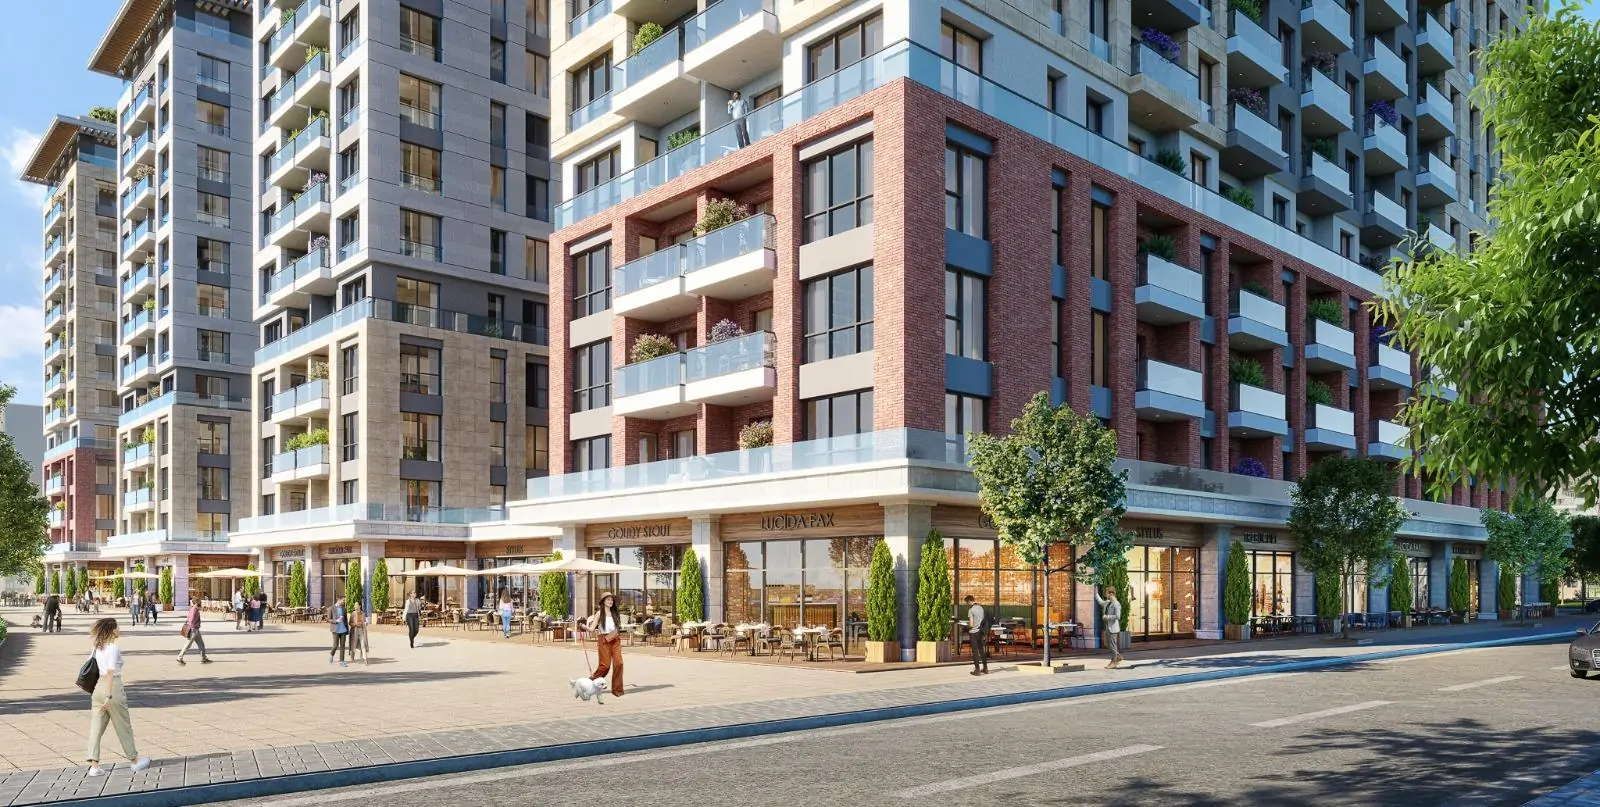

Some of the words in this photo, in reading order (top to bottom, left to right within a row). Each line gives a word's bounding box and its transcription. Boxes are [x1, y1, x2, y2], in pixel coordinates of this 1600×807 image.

[761, 514, 807, 531] LUCIDA
[810, 513, 835, 528] FAX
[608, 526, 641, 540] GOUDY
[643, 524, 672, 538] STOUT
